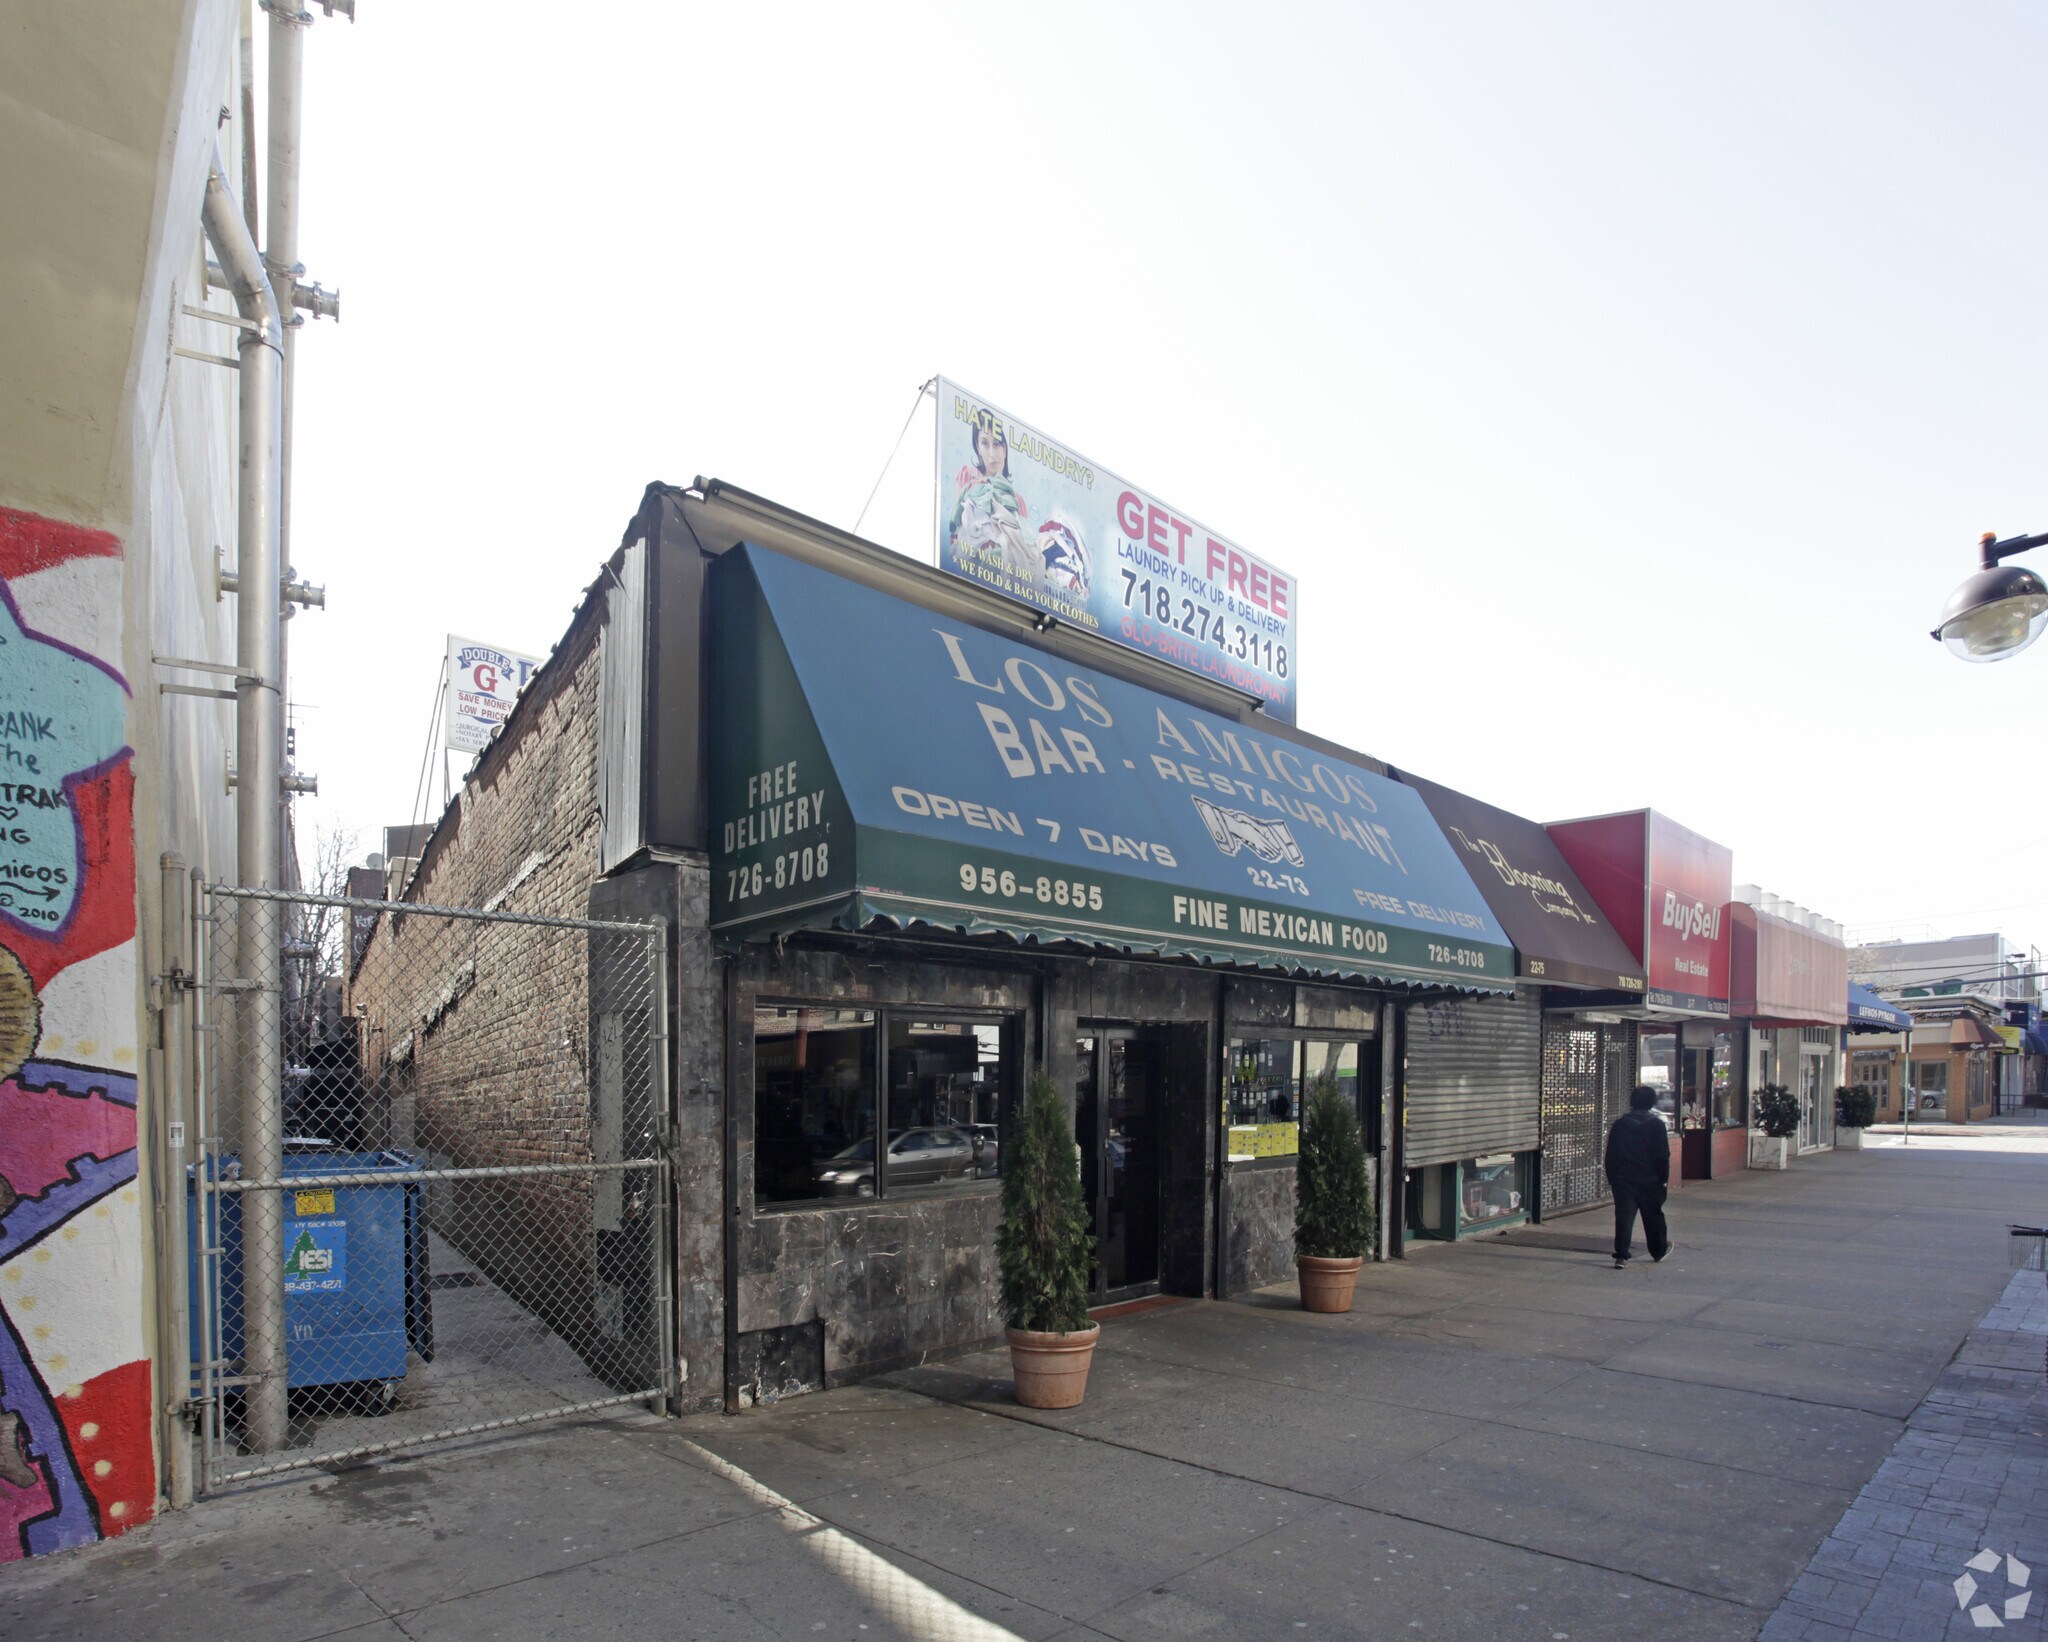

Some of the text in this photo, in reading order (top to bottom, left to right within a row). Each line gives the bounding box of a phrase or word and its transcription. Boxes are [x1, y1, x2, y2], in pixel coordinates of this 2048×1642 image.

[954, 395, 1095, 490] HATE LAUNDRY?
[960, 541, 1034, 583] WE WASH & DRY
[1116, 490, 1289, 620] GET FREE
[960, 558, 1099, 629] WE FOLD & BAG YOUR CLOTHES
[1118, 537, 1286, 638] LAUNDRY PICK UP & DELIVERY
[1121, 567, 1288, 679] 718.274.3118
[463, 648, 511, 670] DOUBLE
[473, 664, 498, 692] G
[932, 627, 1113, 729] LOS
[1121, 615, 1287, 705] GLO-BRITE LAUNDROMAT
[458, 692, 513, 712] SAVE MONEY
[459, 704, 478, 715] LOW
[0, 743, 41, 775] he
[748, 760, 798, 809] FREE
[1156, 705, 1379, 813] AMIGOS
[976, 701, 1409, 875] BAR RESTAURANT
[724, 789, 825, 854] DELIVERY
[890, 786, 1178, 868] OPEN 7 DAYS
[1449, 826, 1480, 852] The
[728, 842, 829, 902] 726-8708
[959, 863, 1103, 911] 956-8855
[1247, 867, 1310, 897] 22-73
[1477, 838, 1573, 905] Blooming
[18, 907, 59, 921] 2010
[1173, 895, 1388, 954] FINE MEXICAN FOOD
[1352, 888, 1486, 931] FREE DELIVERY
[1662, 889, 1721, 941] BuySell
[1428, 943, 1485, 968] 726-8708
[1675, 956, 1708, 977] Real Estate
